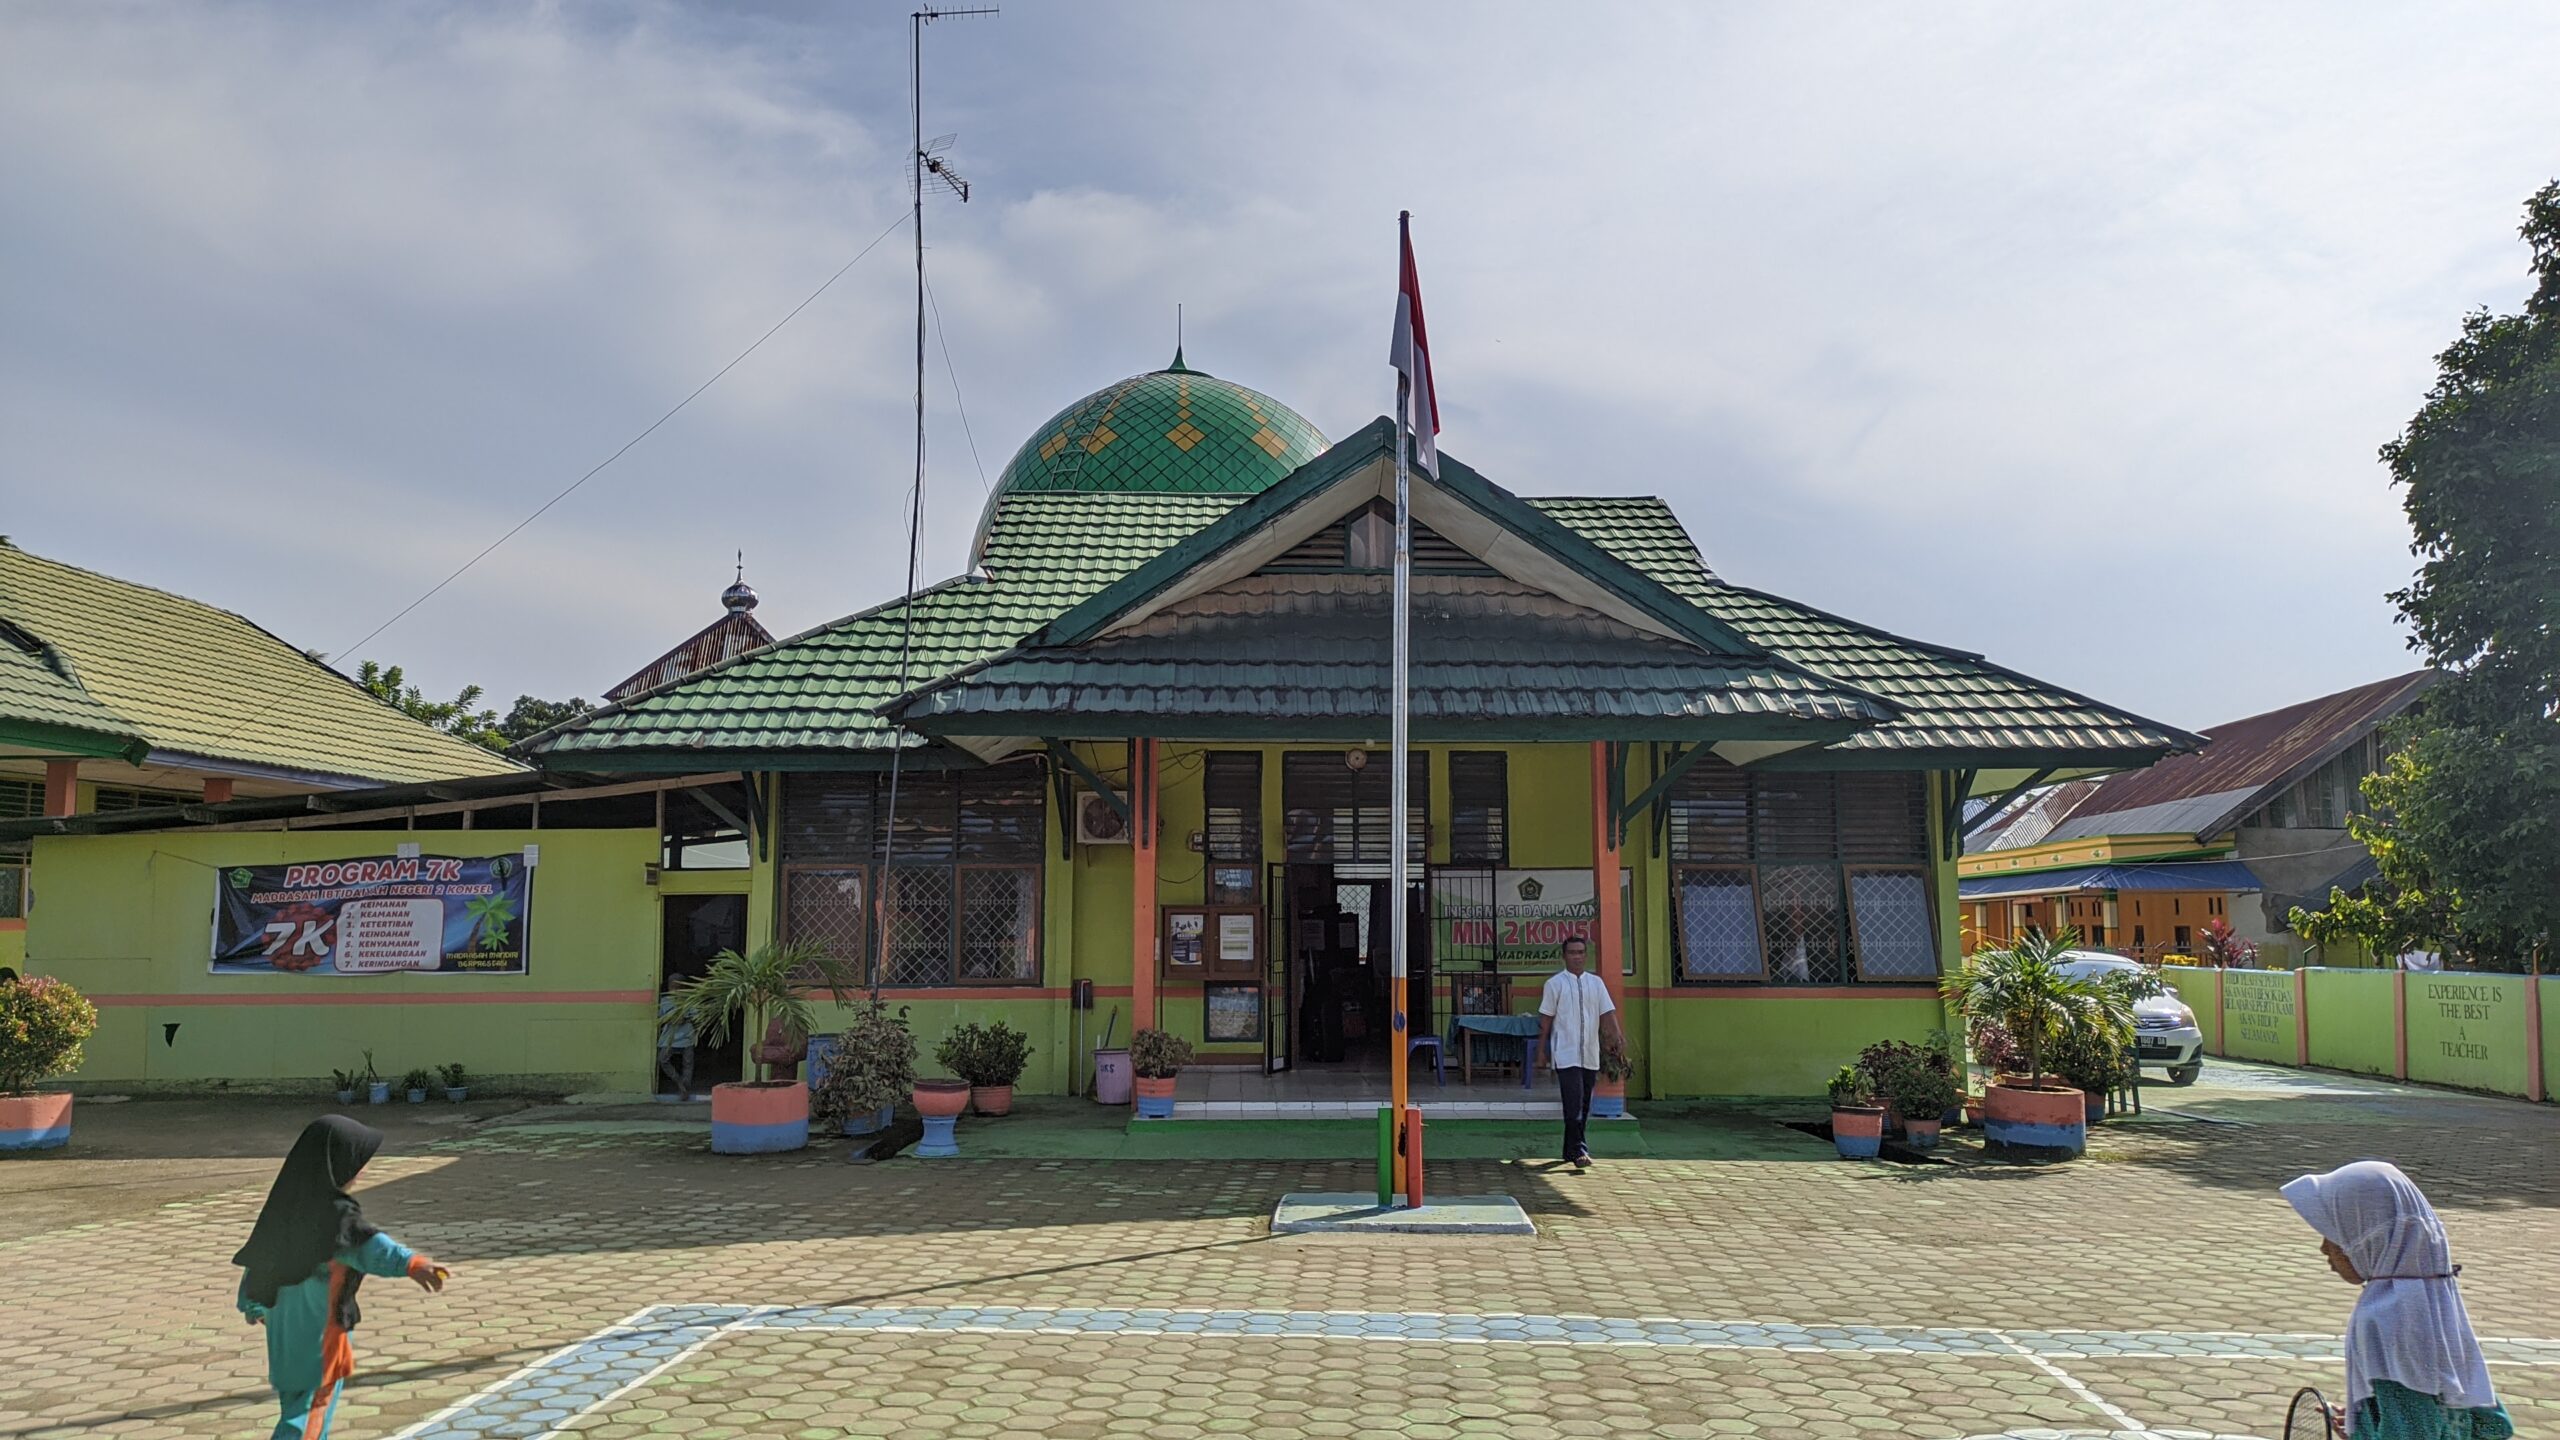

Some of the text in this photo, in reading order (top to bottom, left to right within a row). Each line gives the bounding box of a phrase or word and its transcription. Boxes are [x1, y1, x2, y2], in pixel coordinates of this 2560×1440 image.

[283, 858, 463, 888] PROGRAM 7K
[250, 889, 319, 904] MADRASAH
[390, 884, 433, 896] NEGERI
[435, 885, 444, 895] 2
[446, 883, 493, 895] KONSEL
[360, 901, 408, 909] KEIMANAN
[1444, 904, 1520, 918] INFORMASI
[1523, 904, 1551, 918] DAN
[360, 910, 411, 918] KEAMANAN
[346, 920, 414, 929] 3. KETERTIBAN
[262, 919, 334, 956] 7K
[359, 930, 411, 938] KEINDAHAN
[1452, 920, 1497, 945] MIN
[1504, 920, 1520, 945] 2
[358, 940, 420, 948] KENYAMANAN
[358, 949, 428, 958] KEKELUARGAAN
[358, 960, 420, 968] KERINDANGAN
[2428, 984, 2502, 1003] EXPERIENCE IS
[2438, 1003, 2490, 1020] THE BEST
[2459, 1026, 2466, 1040] A
[2440, 1041, 2488, 1060] TEACHER
